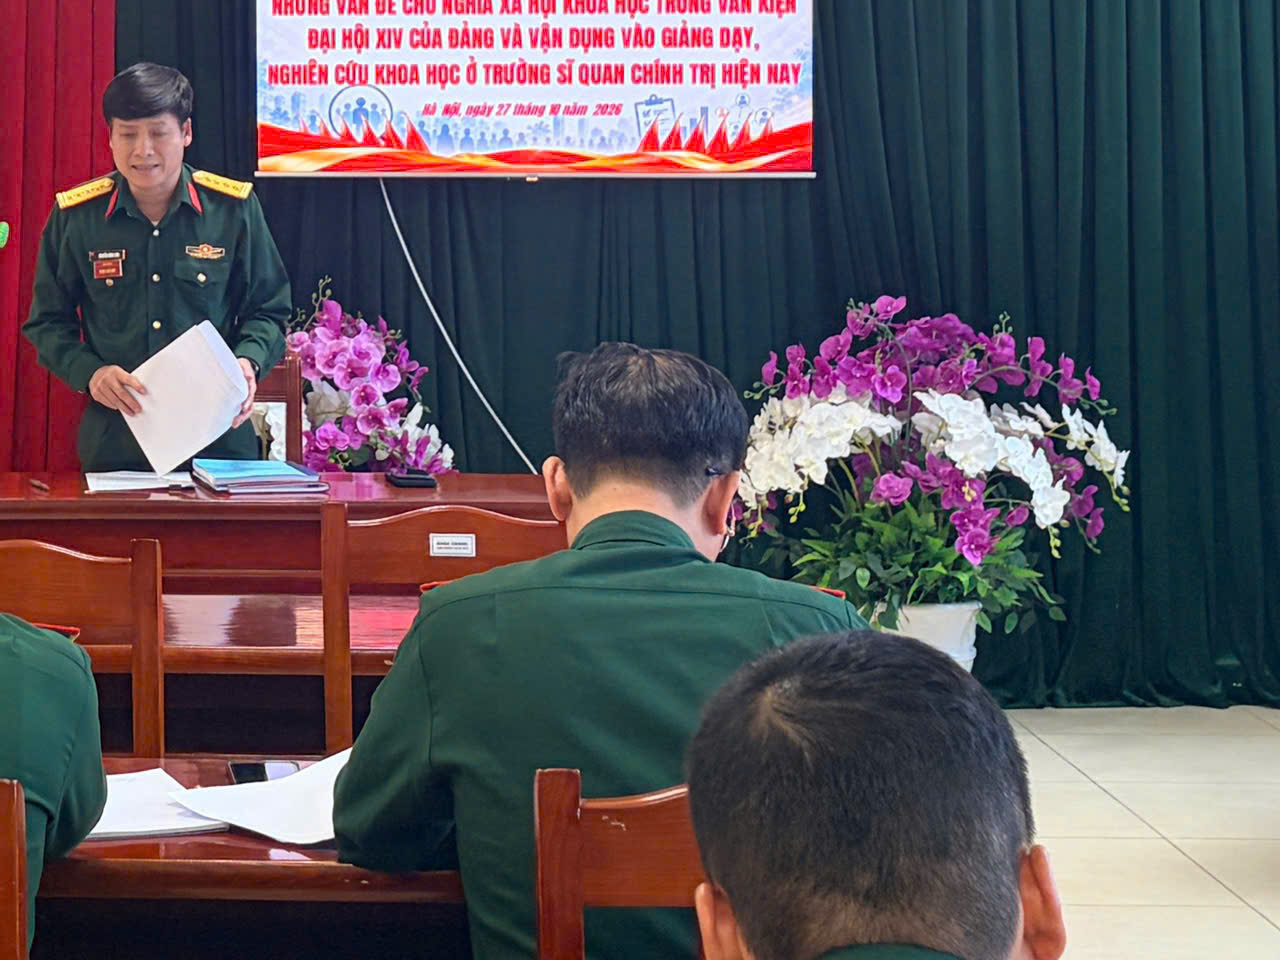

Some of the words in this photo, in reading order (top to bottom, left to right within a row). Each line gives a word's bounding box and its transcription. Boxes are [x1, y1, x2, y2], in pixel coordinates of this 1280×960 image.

[308, 28, 336, 53] ĐẠI
[341, 23, 369, 54] HỘI
[376, 28, 403, 49] XIV
[409, 21, 442, 49] CỦA
[448, 21, 494, 49] ĐẢNG
[500, 23, 522, 49] VÀ
[529, 23, 562, 53] VẬN
[570, 27, 614, 53] DỤNG
[621, 23, 655, 48] VÀO
[661, 20, 713, 48] GIẢNG
[720, 27, 760, 52] DẠY,
[269, 59, 328, 85] NGHIÊN
[335, 60, 369, 84] CỨU
[375, 64, 419, 85] KHOA
[426, 64, 460, 89] HỌC
[466, 56, 477, 84] Ở
[483, 58, 551, 85] TRƯỜNG
[557, 59, 575, 84] SĨ
[579, 63, 624, 86] QUAN
[631, 59, 683, 84] CHÍNH
[689, 63, 715, 89] TRỊ
[722, 58, 760, 88] HIỆN
[767, 63, 801, 84] NAY
[422, 102, 437, 116] Hà
[465, 104, 494, 118] ngày
[496, 104, 511, 116] 27
[513, 103, 546, 117] tháng
[563, 102, 588, 116] năm
[593, 104, 623, 116] 2026
